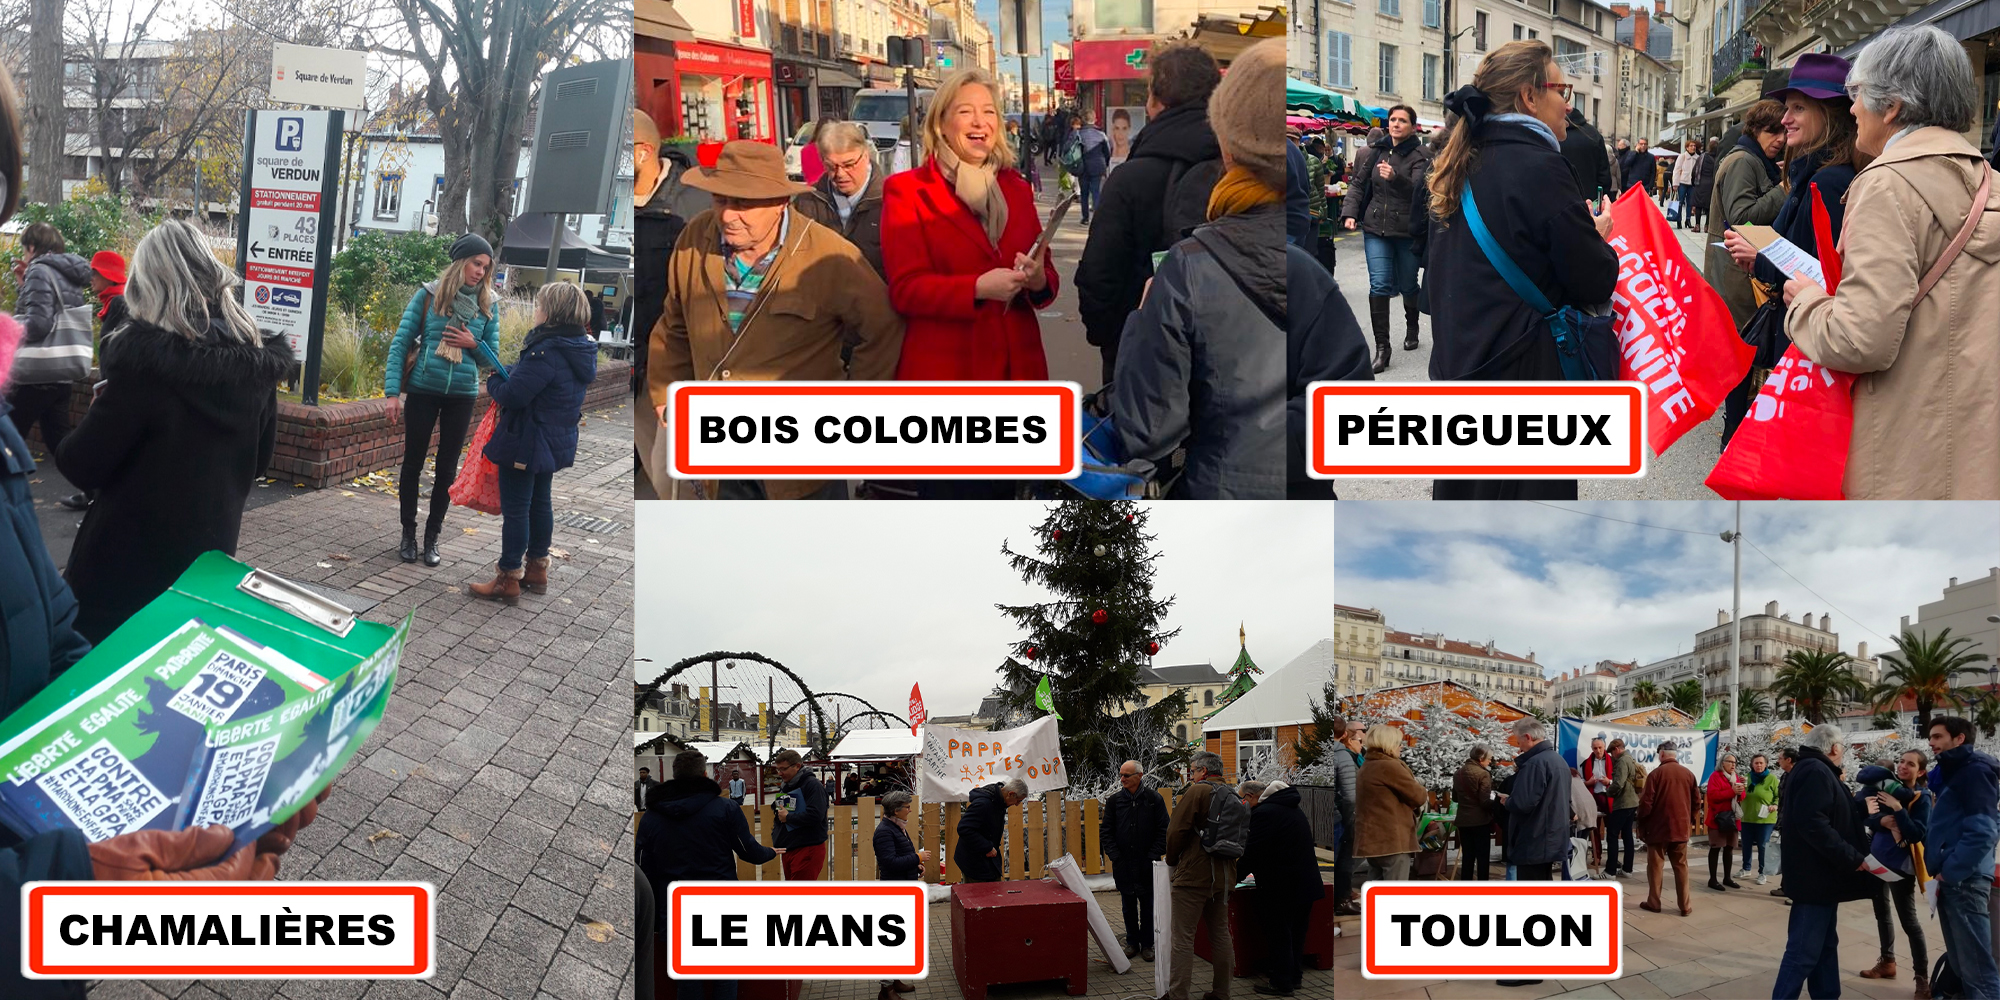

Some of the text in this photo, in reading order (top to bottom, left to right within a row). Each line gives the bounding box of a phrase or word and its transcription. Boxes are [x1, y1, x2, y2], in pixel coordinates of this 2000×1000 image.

[295, 70, 353, 85] Square de Verdun
[257, 157, 304, 168] square de
[271, 167, 320, 182] VERDUN
[254, 190, 318, 202] STATIONNEMENT
[294, 216, 316, 235] 43
[283, 233, 315, 244] PLACES
[268, 247, 314, 263] ENTRÉE
[191, 673, 243, 710] 19
[178, 692, 226, 720] JANVIER
[948, 738, 1003, 759] PAPA
[924, 753, 947, 780] SARTHE
[985, 753, 1061, 779] T'ES OÙ?
[76, 757, 125, 804] LA PMA
[91, 746, 163, 813] CONTRE
[236, 740, 276, 820] CONTRE
[59, 769, 129, 837] ET LA GPA
